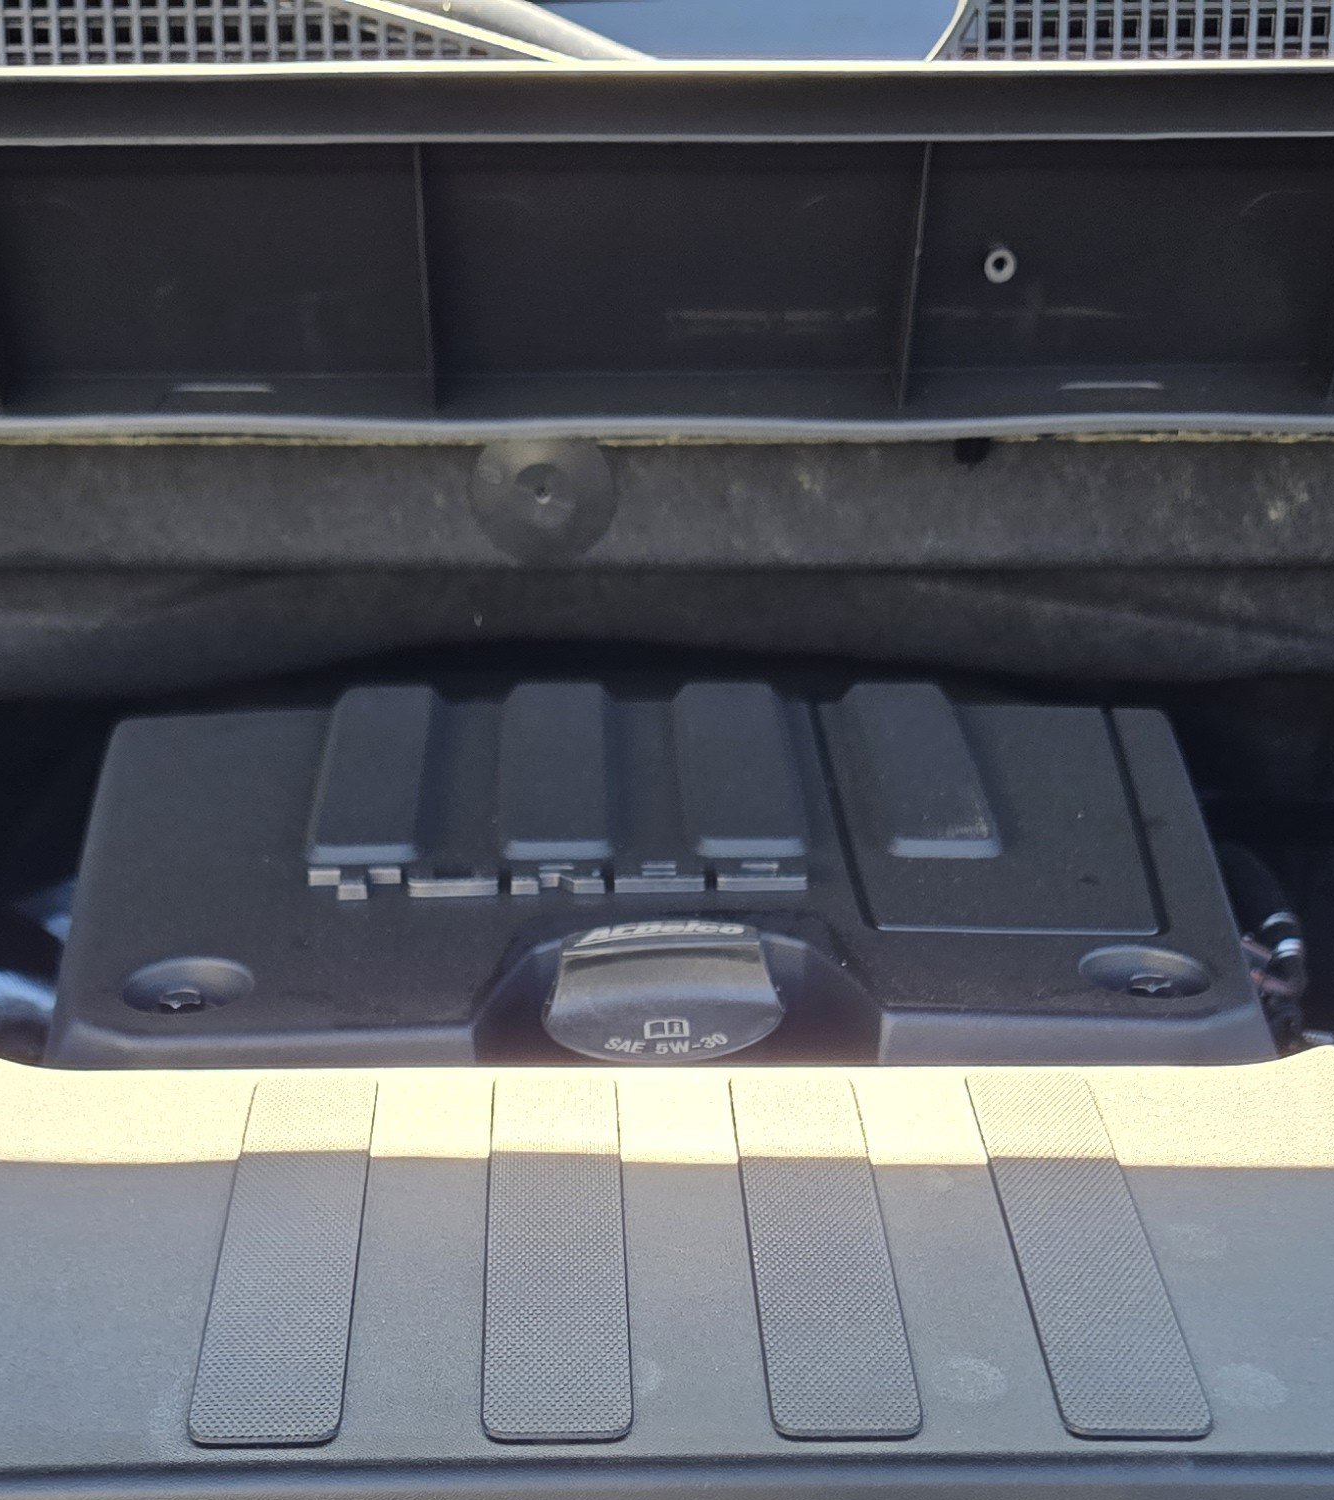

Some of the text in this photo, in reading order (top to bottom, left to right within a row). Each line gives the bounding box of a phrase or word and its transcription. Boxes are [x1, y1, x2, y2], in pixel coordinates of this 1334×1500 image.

[576, 920, 745, 946] ACDelco
[604, 1033, 729, 1055] SAE 5W-30
